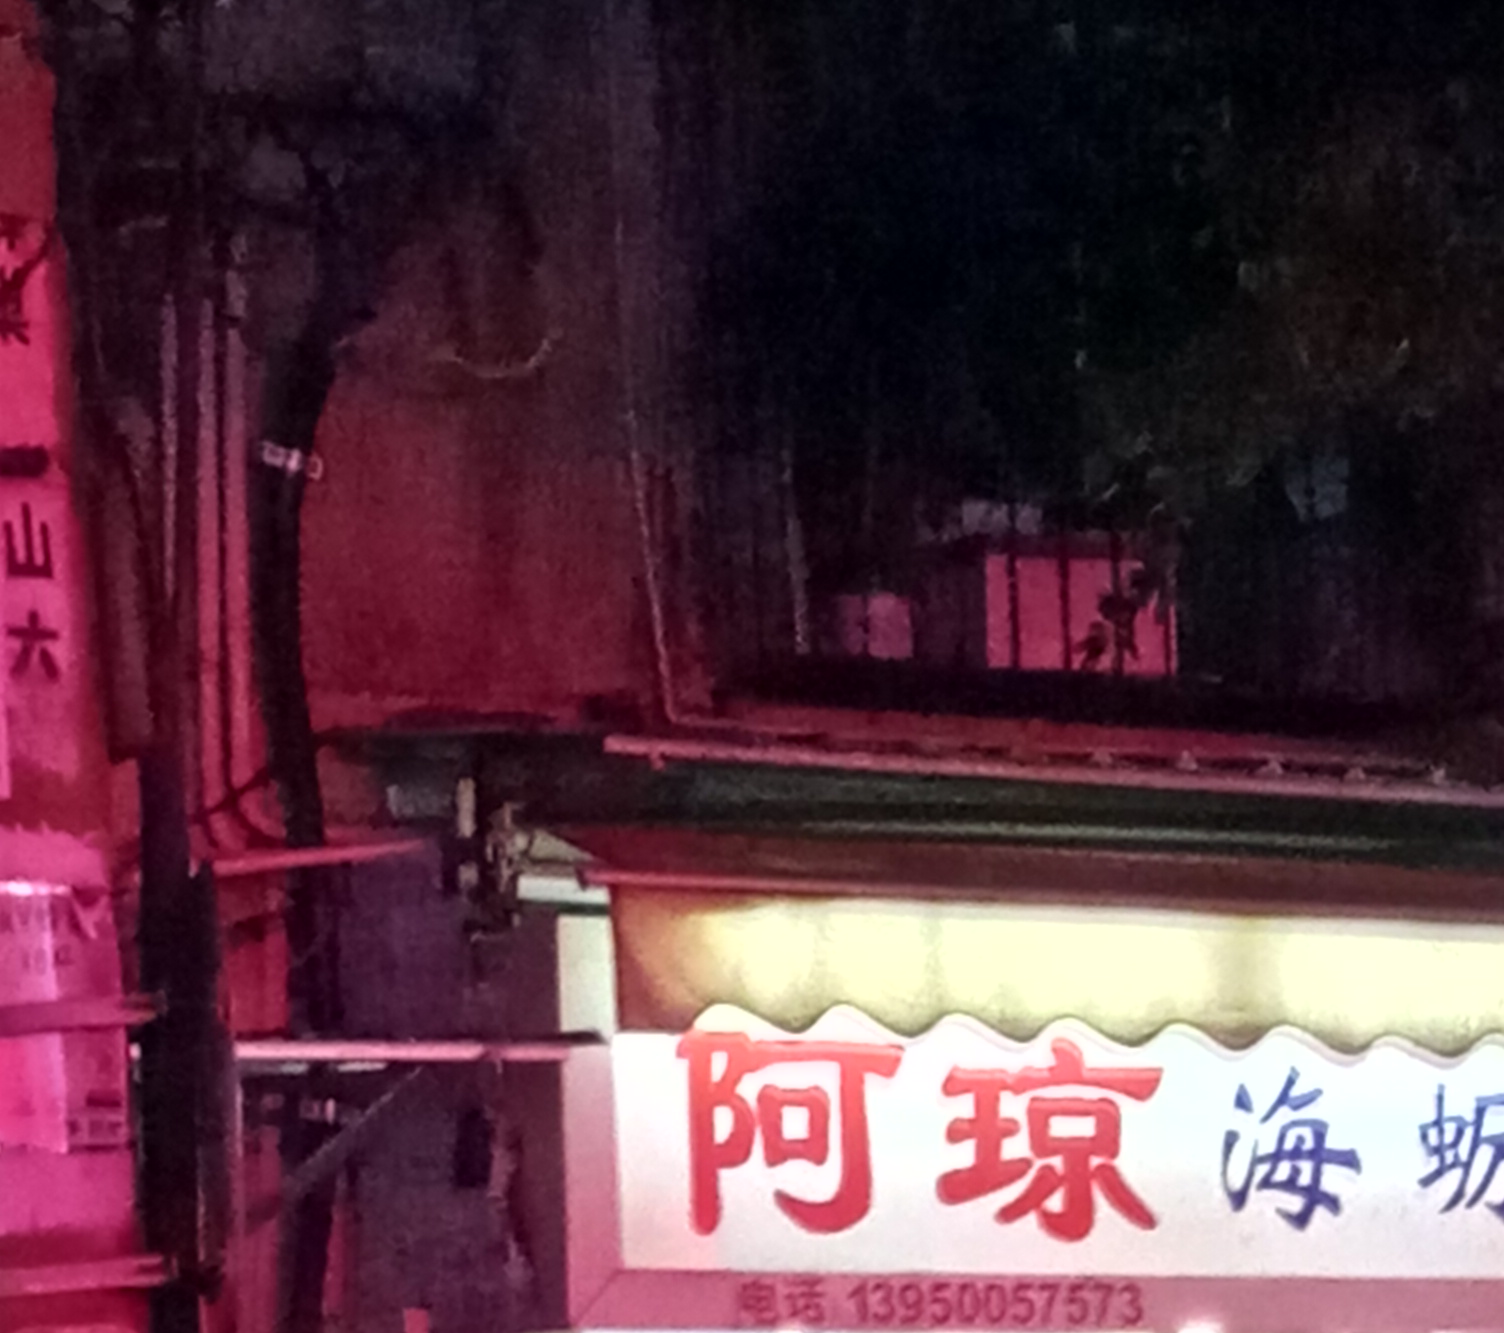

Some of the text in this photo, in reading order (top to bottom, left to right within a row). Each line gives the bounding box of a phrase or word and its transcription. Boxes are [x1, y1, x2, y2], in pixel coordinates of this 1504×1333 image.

[676, 1030, 1164, 1243] 阿琼
[736, 1279, 1143, 1328] 电话 13950057573
